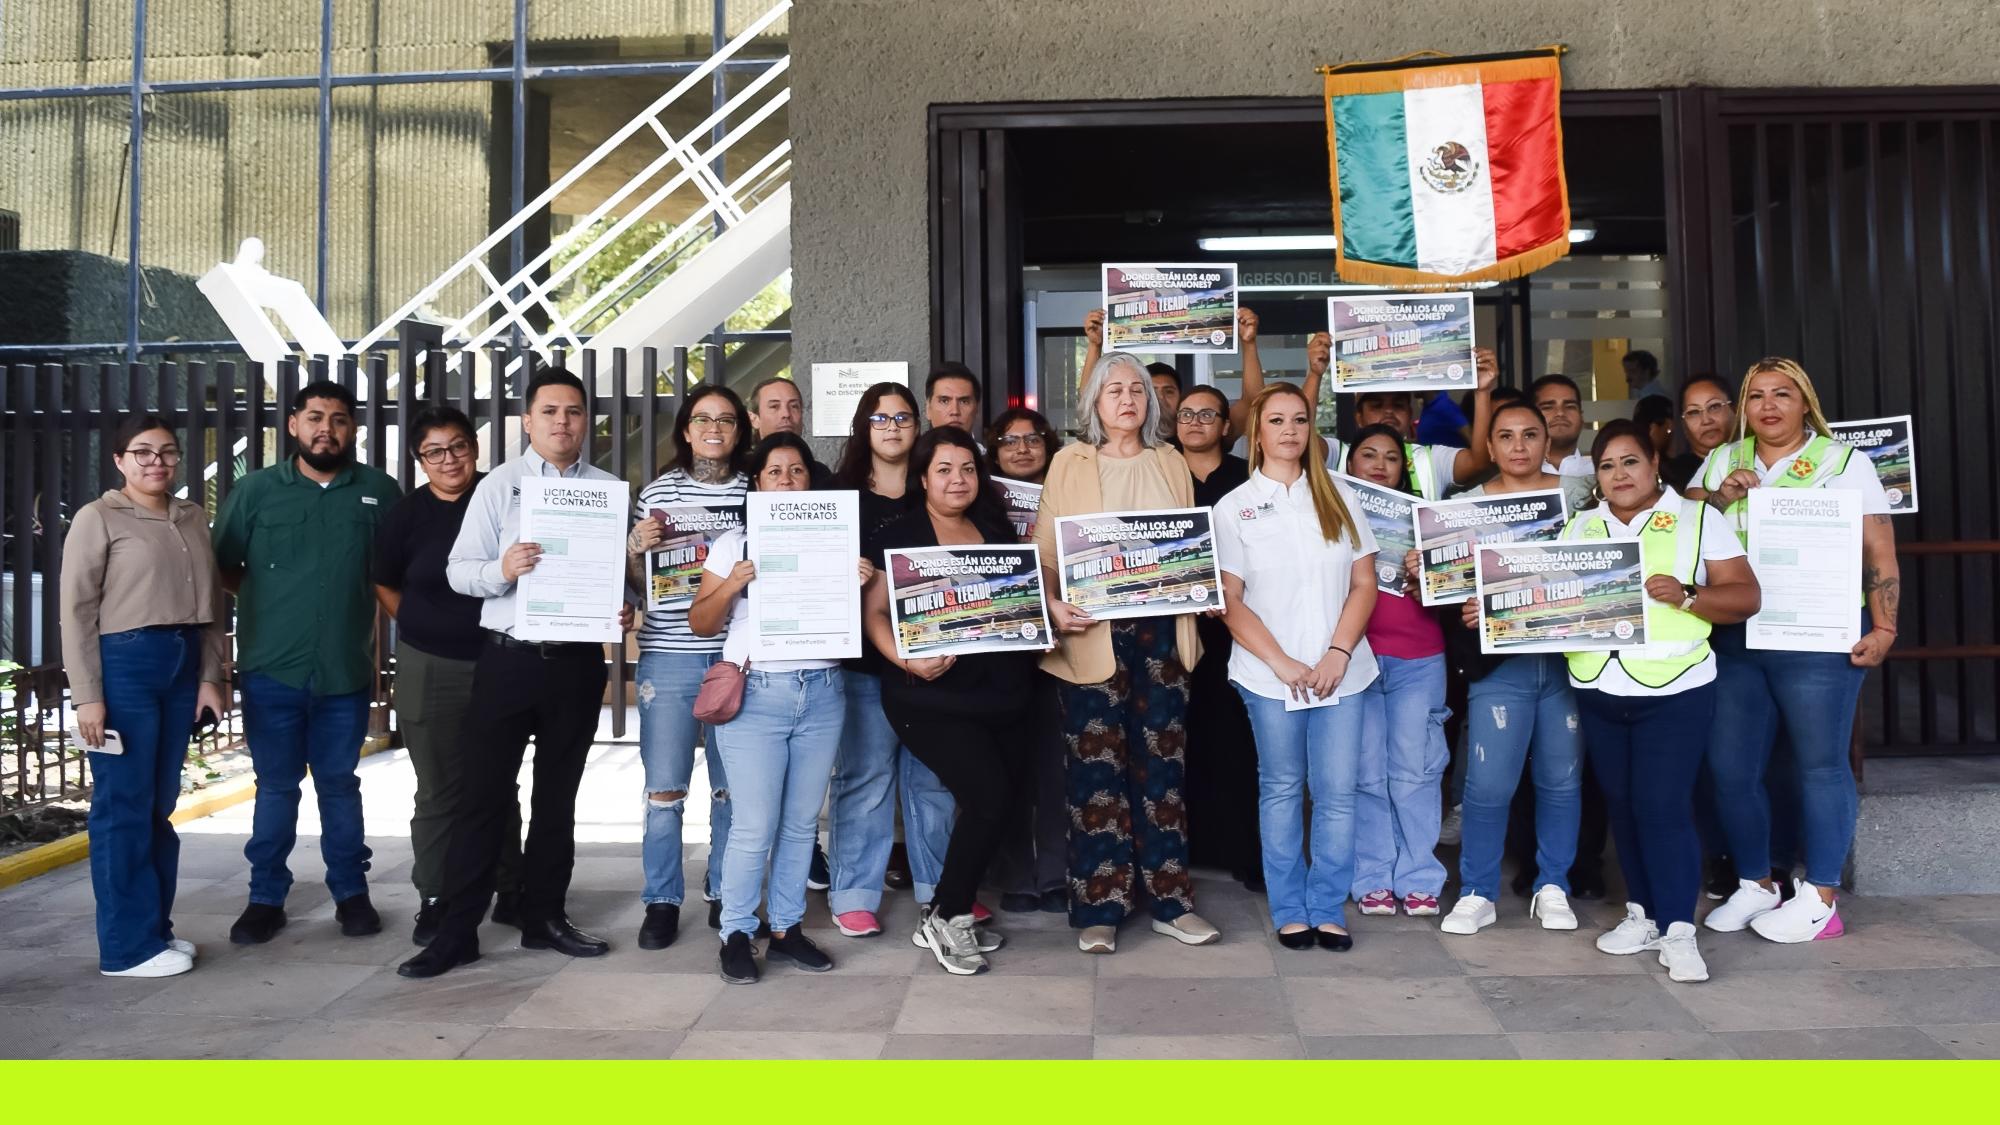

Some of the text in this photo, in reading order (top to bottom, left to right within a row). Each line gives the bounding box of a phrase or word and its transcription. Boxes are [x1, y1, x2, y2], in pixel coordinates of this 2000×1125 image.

[1183, 273, 1197, 281] LOS
[1298, 272, 1326, 285] DEL
[1413, 304, 1430, 313] LOS
[1357, 314, 1392, 323] NUEVOS
[1848, 431, 1866, 440] LOS
[1867, 428, 1893, 439] 4,000
[544, 488, 608, 500] LICITACIONES
[543, 497, 608, 508] Y CONTRATOS
[770, 502, 837, 512] LICITACIONES
[1370, 495, 1387, 507] LOS
[1388, 501, 1411, 515] 4,000
[1771, 498, 1840, 509] LICITACIONES
[665, 513, 703, 525] ¿DONDE
[705, 510, 733, 521] ESTÁN
[770, 511, 838, 521] Y CONTRATOS
[1434, 502, 1547, 523] ¿DONDE ESTÁN LOS 4,000
[1771, 507, 1840, 517] Y CONTRATOS
[675, 521, 712, 531] NUEVOS
[1444, 511, 1538, 529] NUEVOS CAMIONES?
[1078, 520, 1194, 537] ¿DONDE ESTÁN LOS 4,000
[1088, 529, 1184, 543] NUEVOS CAMIONES?
[670, 546, 696, 566] NUEVO
[908, 554, 1021, 571] ¿DONDE ESTÁN LOS 4,000
[1497, 550, 1623, 566] ¿DONDE ESTÁN LOS 4,000
[919, 563, 1013, 577] NUEVOS CAMIONES?
[1073, 547, 1161, 580] UN NUEVO LEGADO
[1508, 560, 1612, 573] NUEVOS CAMIONES?
[904, 582, 993, 615] UN NUEVO LEGADO
[1504, 588, 1533, 609] NUEVO
[1546, 579, 1585, 601] LEGADO
